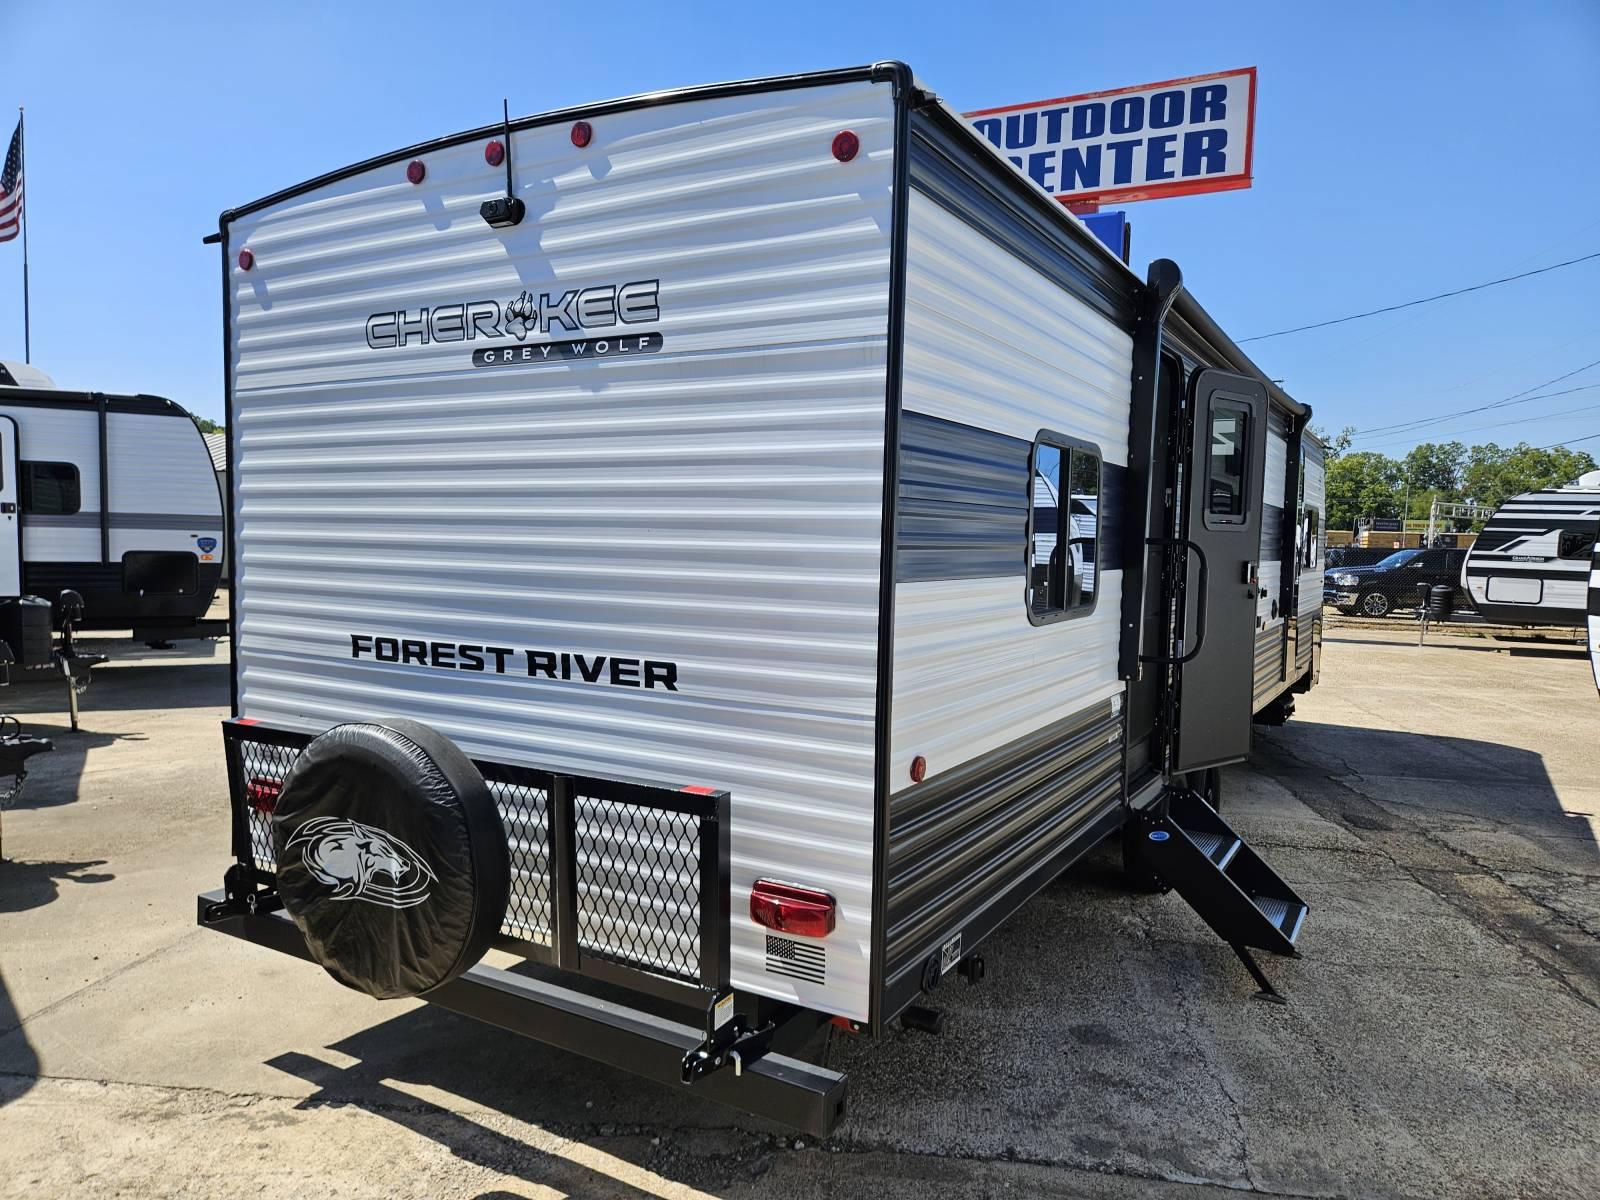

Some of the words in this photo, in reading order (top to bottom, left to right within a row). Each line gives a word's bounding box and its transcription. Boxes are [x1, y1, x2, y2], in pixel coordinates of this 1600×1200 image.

[972, 84, 1228, 150] OUTDOOR
[1008, 128, 1228, 193] ENTER
[483, 345, 552, 363] GREY
[571, 336, 650, 355] WOLF
[350, 634, 514, 674] FOREST
[525, 649, 679, 691] RIVER
